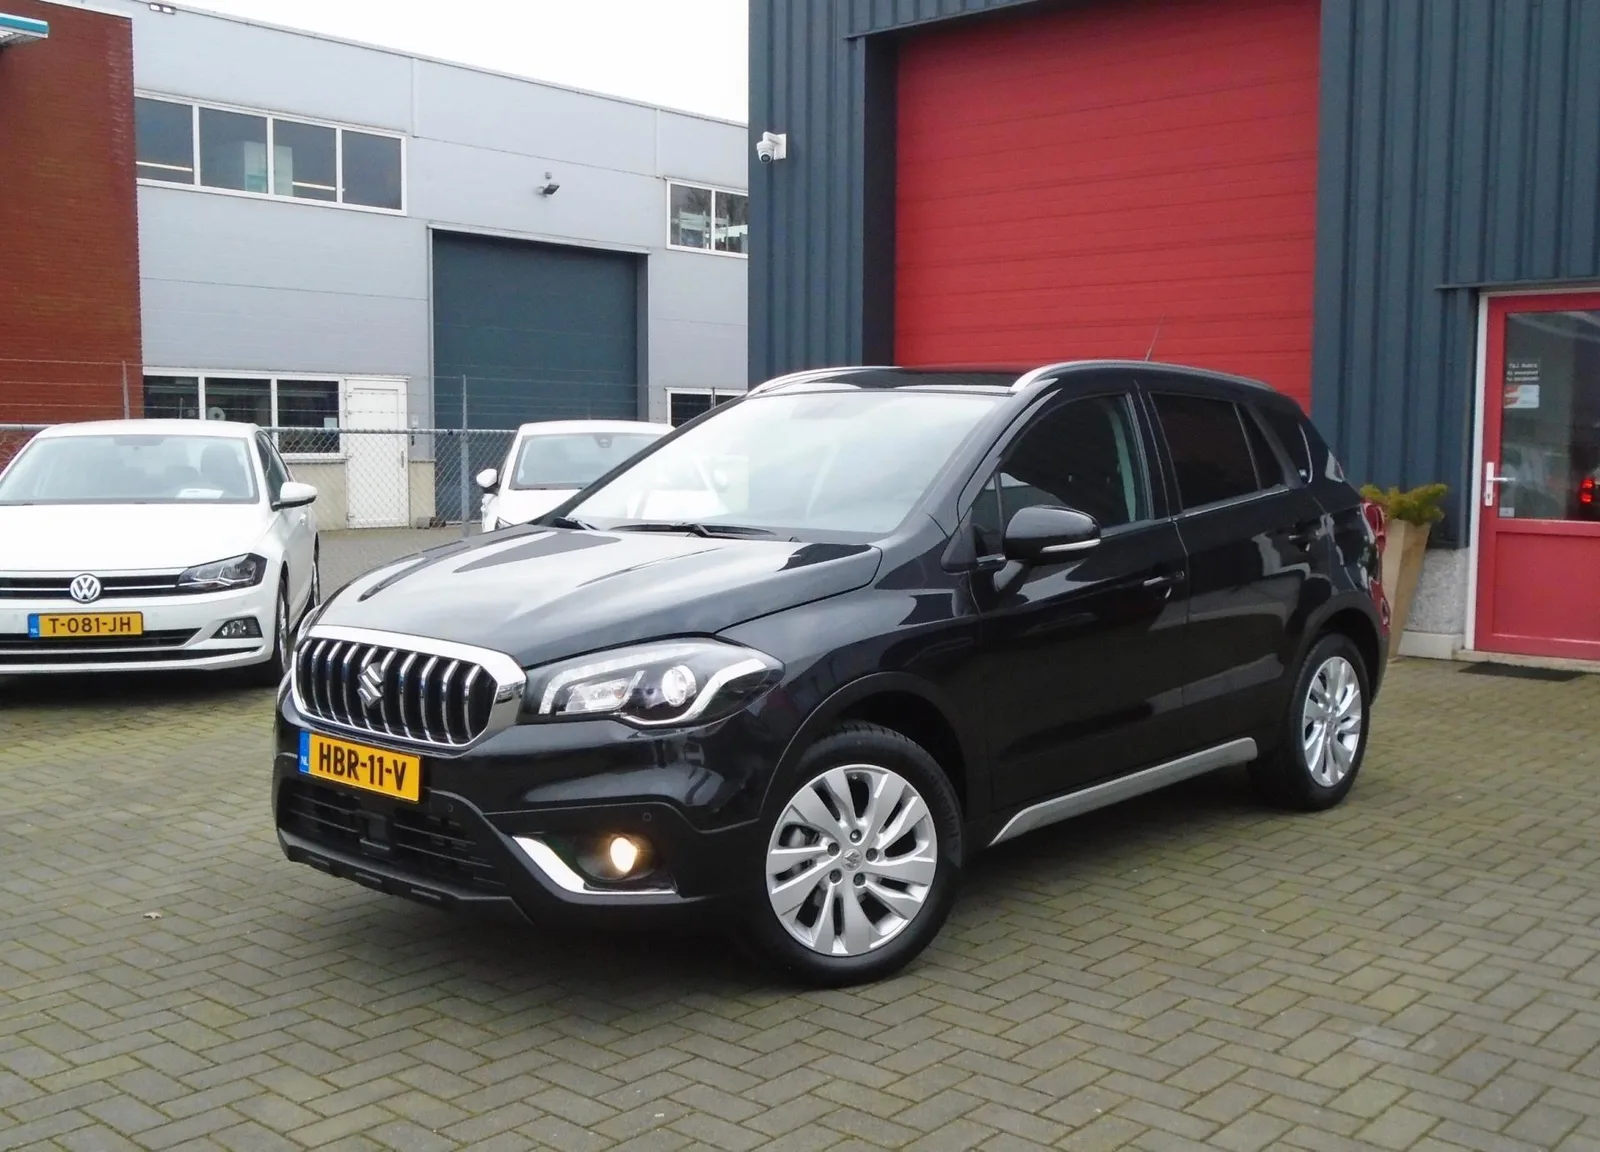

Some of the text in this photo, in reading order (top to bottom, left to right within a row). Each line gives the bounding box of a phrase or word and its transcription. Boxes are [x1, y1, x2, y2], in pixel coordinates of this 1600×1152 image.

[71, 575, 100, 601] VW
[48, 617, 131, 633] T-081-JH
[318, 742, 406, 791] HBR-11-V
